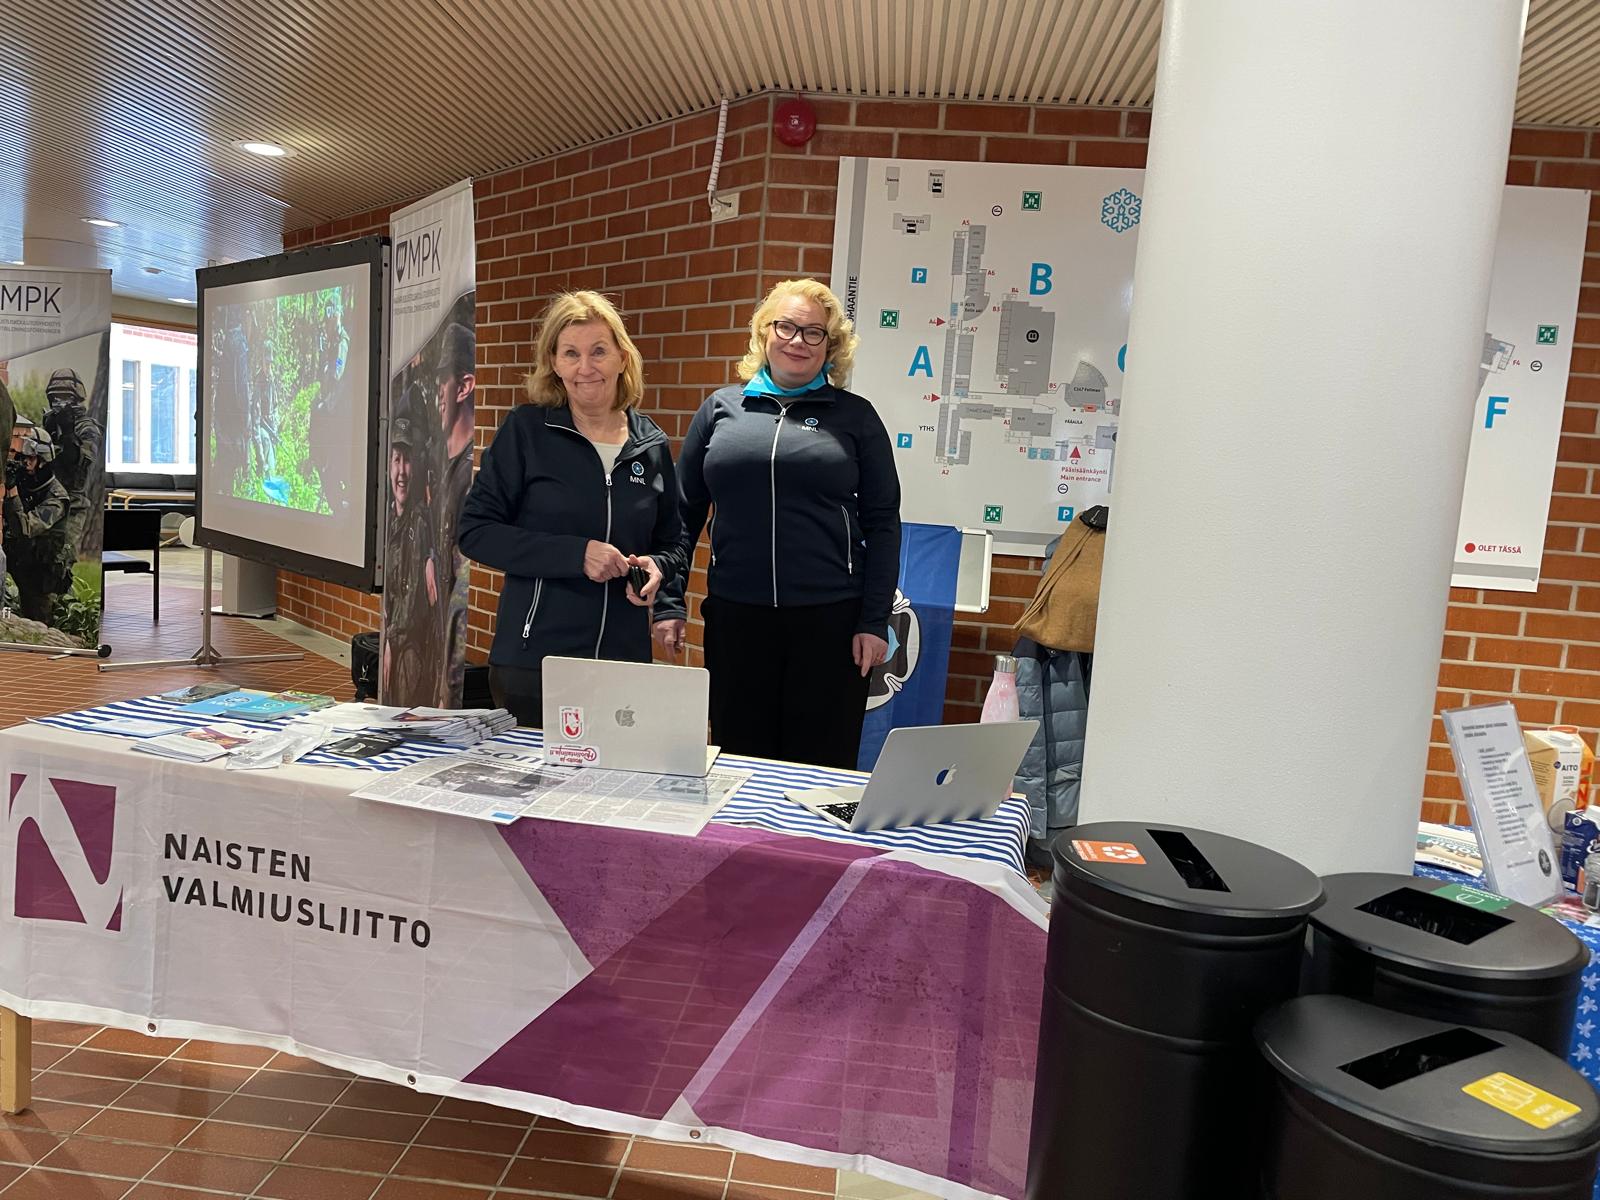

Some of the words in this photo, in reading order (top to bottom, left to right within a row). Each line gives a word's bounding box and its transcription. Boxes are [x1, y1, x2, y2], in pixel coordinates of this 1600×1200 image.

[408, 227, 442, 280] MPK
[1029, 262, 1053, 295] B
[0, 285, 61, 313] MPK
[908, 345, 934, 377] A
[1485, 396, 1510, 429] F
[801, 425, 819, 433] MNL
[629, 475, 646, 485] MNL
[1061, 466, 1108, 476] Pääsisäänkäynti
[1478, 544, 1497, 553] OLET
[1498, 545, 1522, 554] TÄSSÄ
[164, 833, 310, 882] NAISTEN
[162, 875, 431, 948] VALMIUSLIITTO
